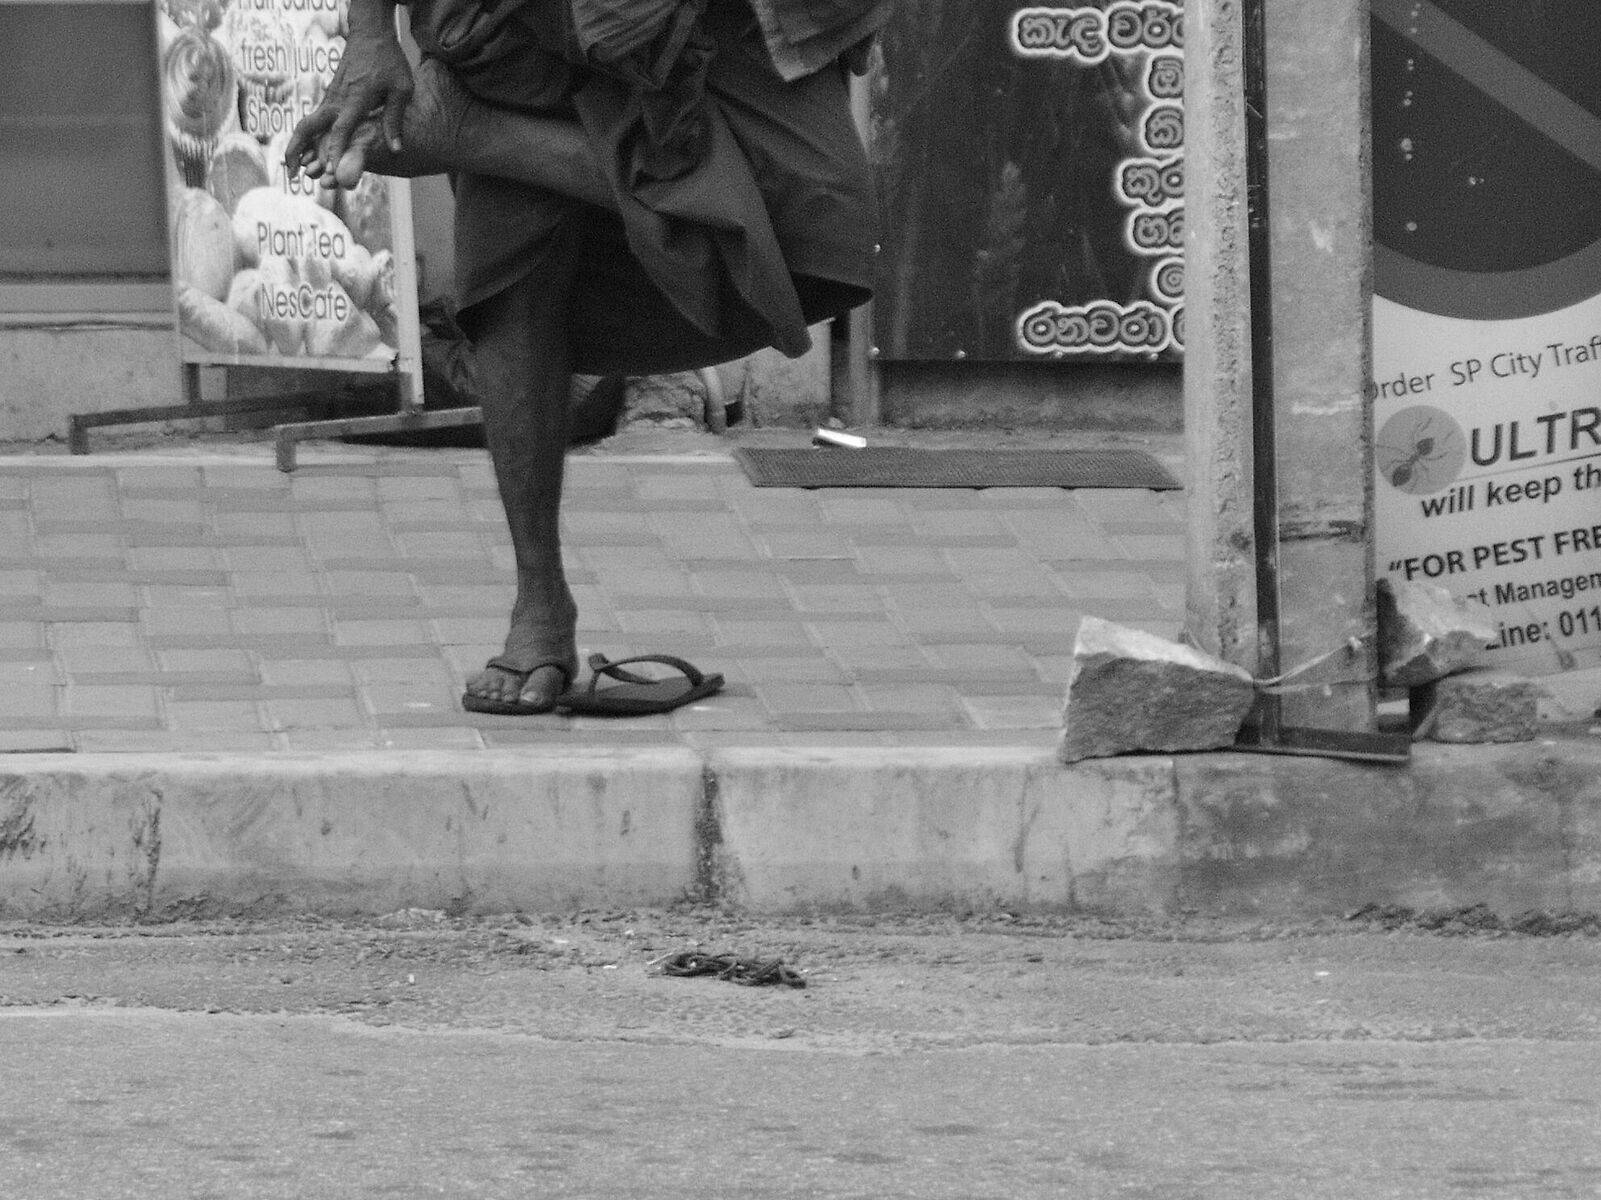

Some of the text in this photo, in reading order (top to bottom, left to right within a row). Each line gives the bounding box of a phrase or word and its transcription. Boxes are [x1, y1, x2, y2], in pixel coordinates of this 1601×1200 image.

[241, 38, 341, 79] fresh juice
[247, 99, 295, 133] Short
[280, 160, 315, 195] Tea
[257, 222, 346, 259] Plant Tea
[261, 283, 348, 321] NesCafe
[1450, 358, 1482, 386] SP
[1491, 352, 1542, 378] City
[1471, 406, 1601, 467] ULTR
[1421, 485, 1475, 518] will
[1487, 476, 1562, 507] keep
[1473, 535, 1545, 569] PEST
[1485, 605, 1601, 650] ine: 011
